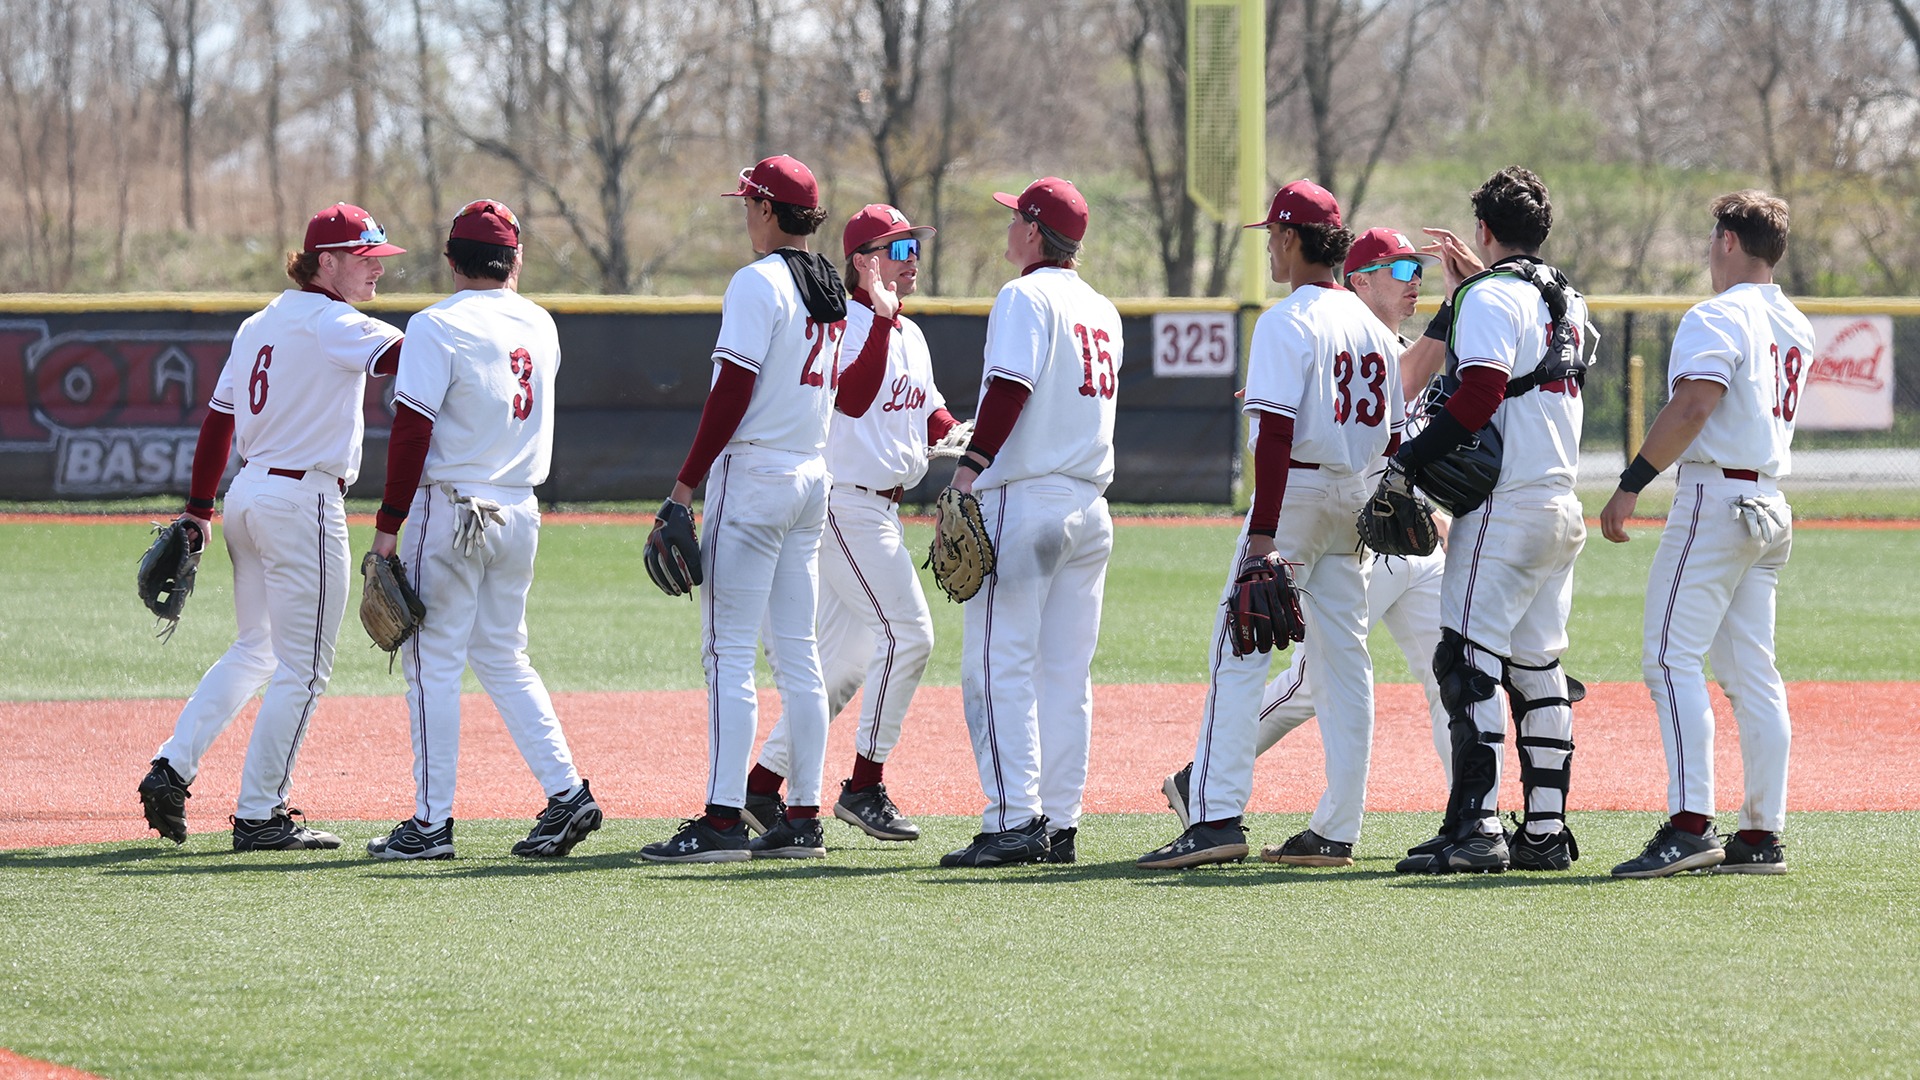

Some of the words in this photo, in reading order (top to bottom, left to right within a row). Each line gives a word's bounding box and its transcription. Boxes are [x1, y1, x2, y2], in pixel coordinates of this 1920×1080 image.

[248, 344, 275, 416] 6
[1073, 322, 1116, 400] 15
[1161, 322, 1229, 366] 325
[509, 347, 534, 422] 3
[1333, 350, 1387, 428] 33
[1769, 342, 1804, 423] 18
[65, 440, 202, 483] BASE
